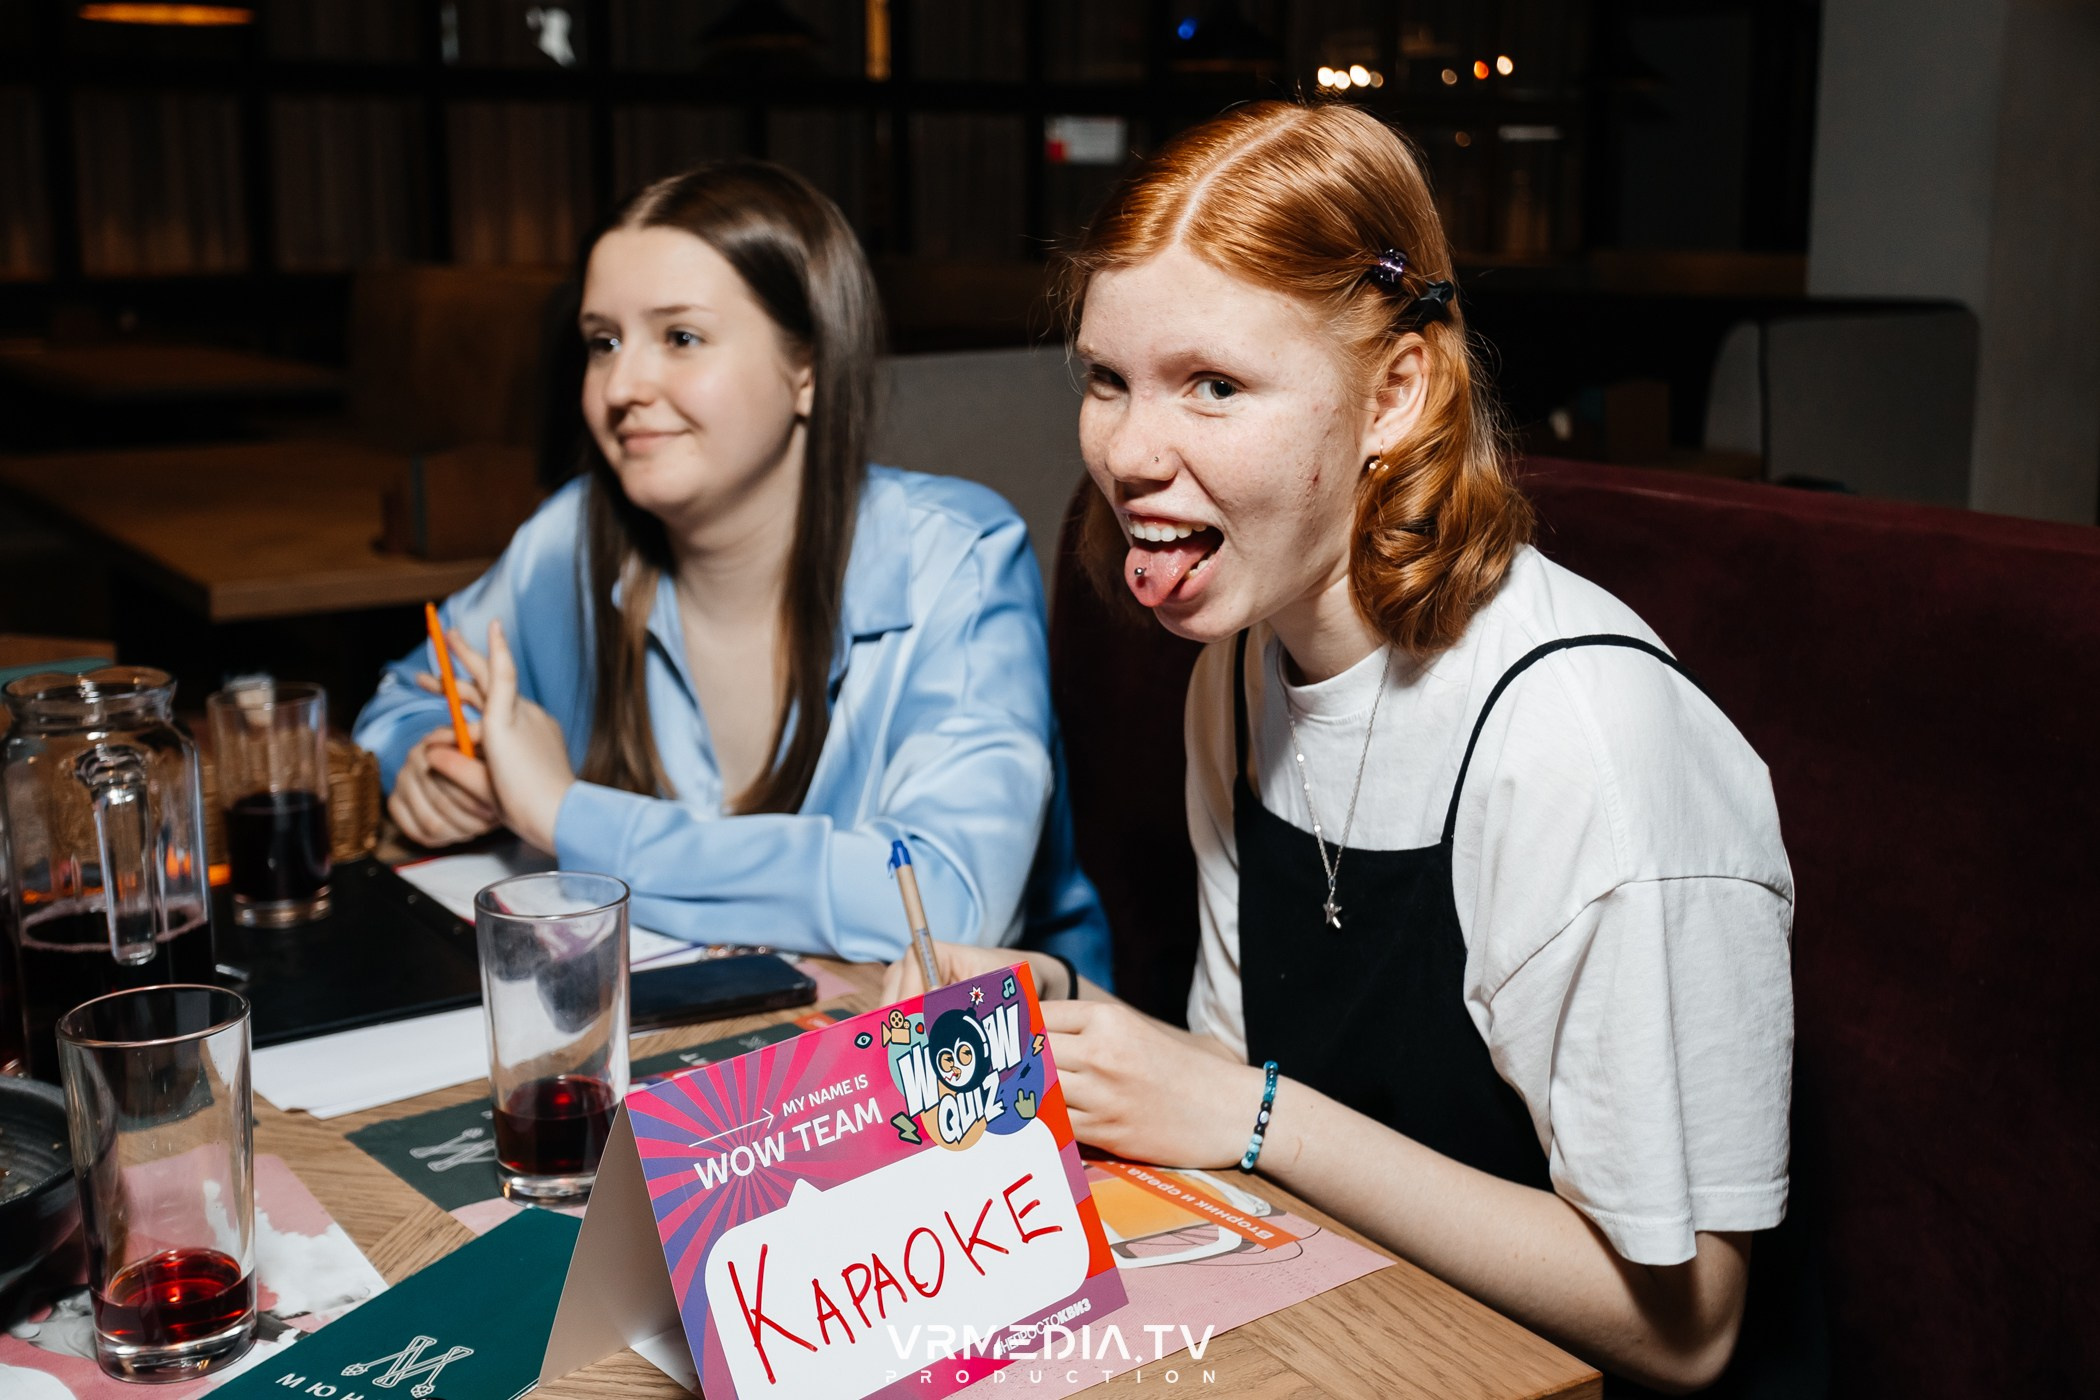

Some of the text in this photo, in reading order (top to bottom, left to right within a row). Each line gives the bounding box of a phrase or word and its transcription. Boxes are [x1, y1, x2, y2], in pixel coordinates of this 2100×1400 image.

[782, 1074, 869, 1117] MY NAME IS
[937, 1069, 1006, 1145] QUIZ
[693, 1097, 883, 1190] WOW TEAM
[1127, 1167, 1275, 1240] Вторник и среда
